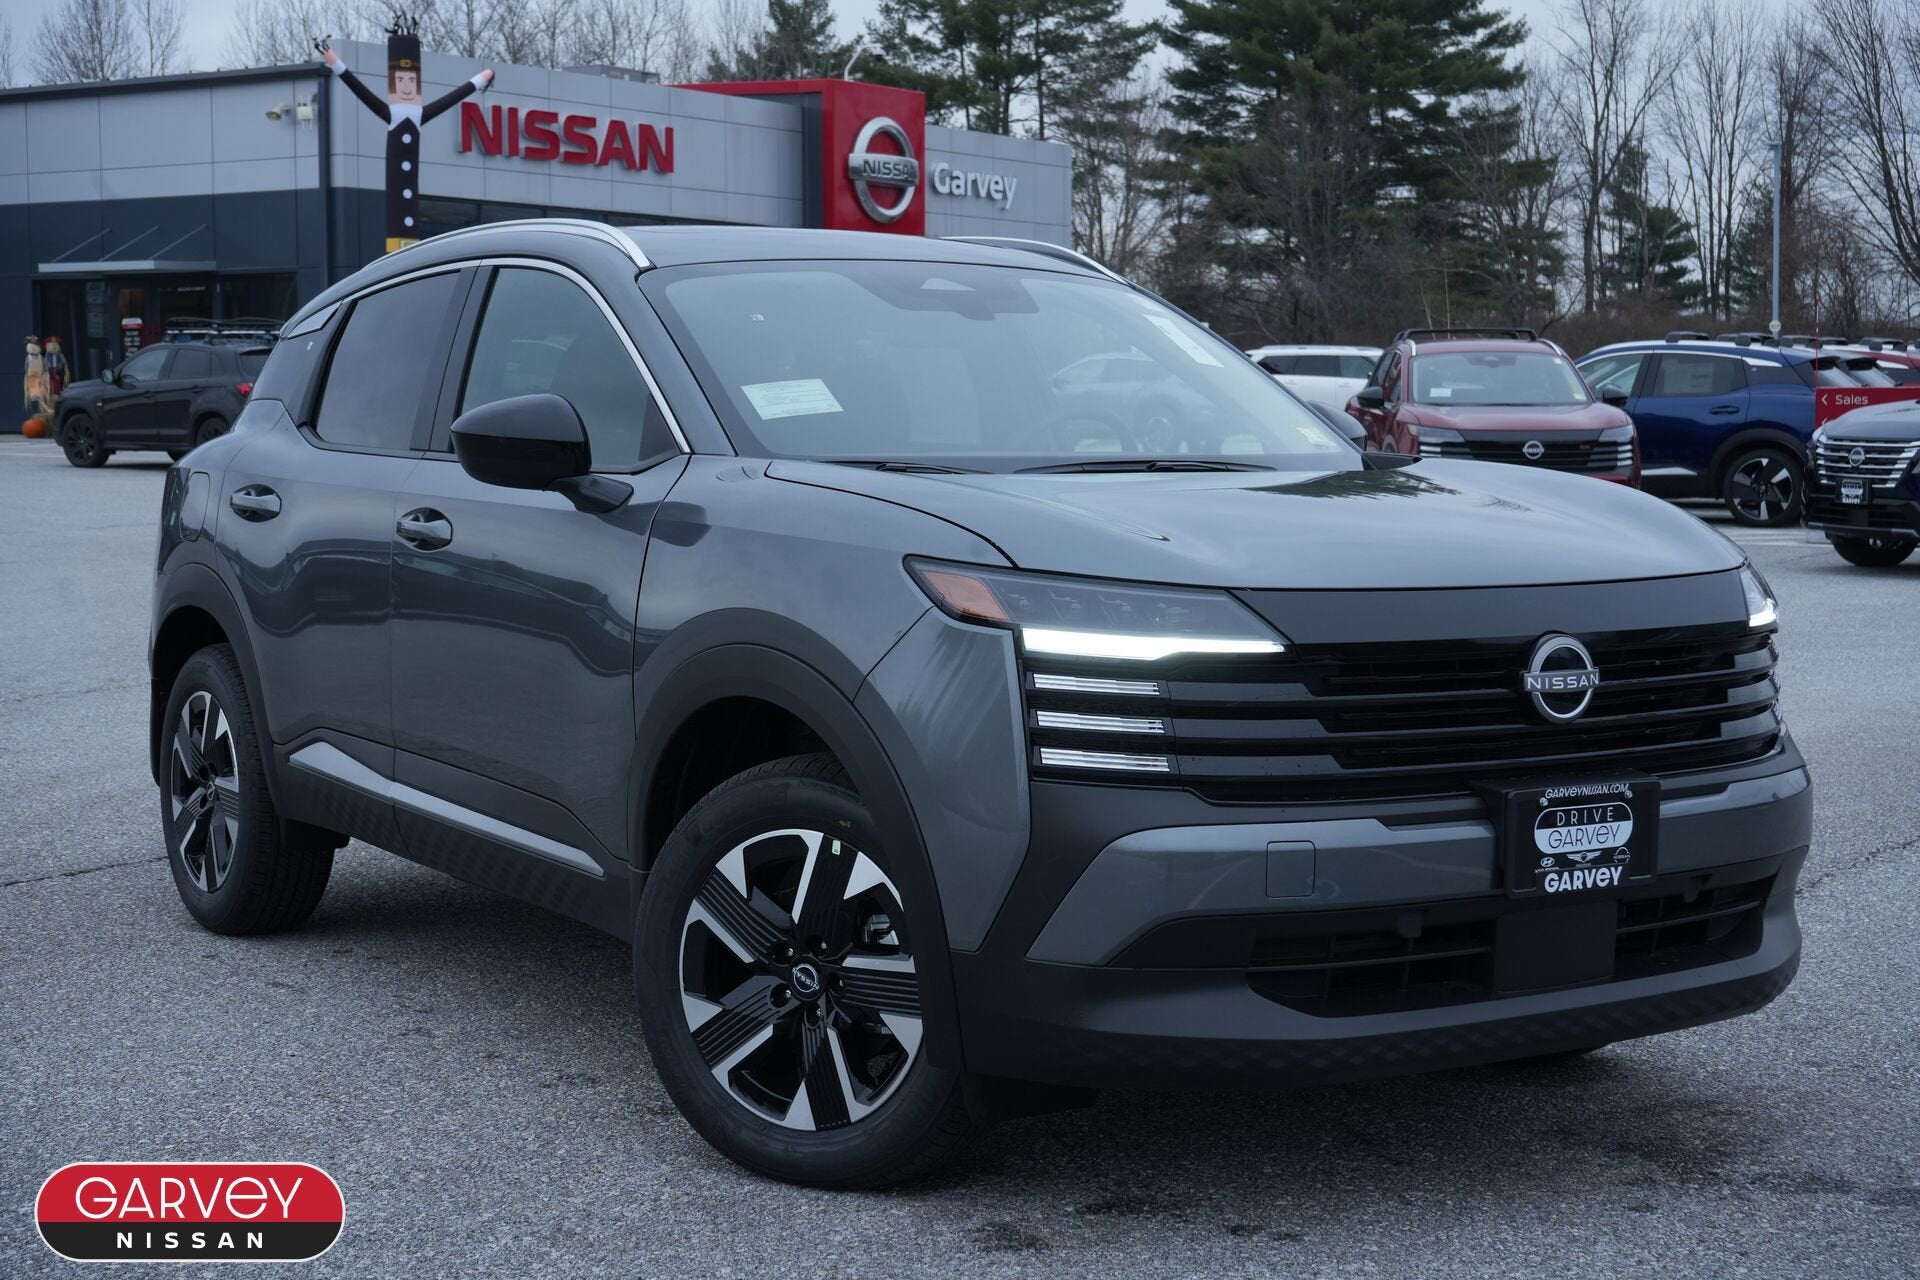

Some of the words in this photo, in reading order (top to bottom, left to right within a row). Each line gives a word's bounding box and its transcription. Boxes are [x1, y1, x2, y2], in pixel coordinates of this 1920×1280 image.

[460, 101, 675, 174] NISSAN
[933, 162, 1017, 209] Garvey
[1835, 394, 1869, 405] Sales
[1527, 673, 1599, 689] NISSAN
[1556, 807, 1614, 826] DRIVE
